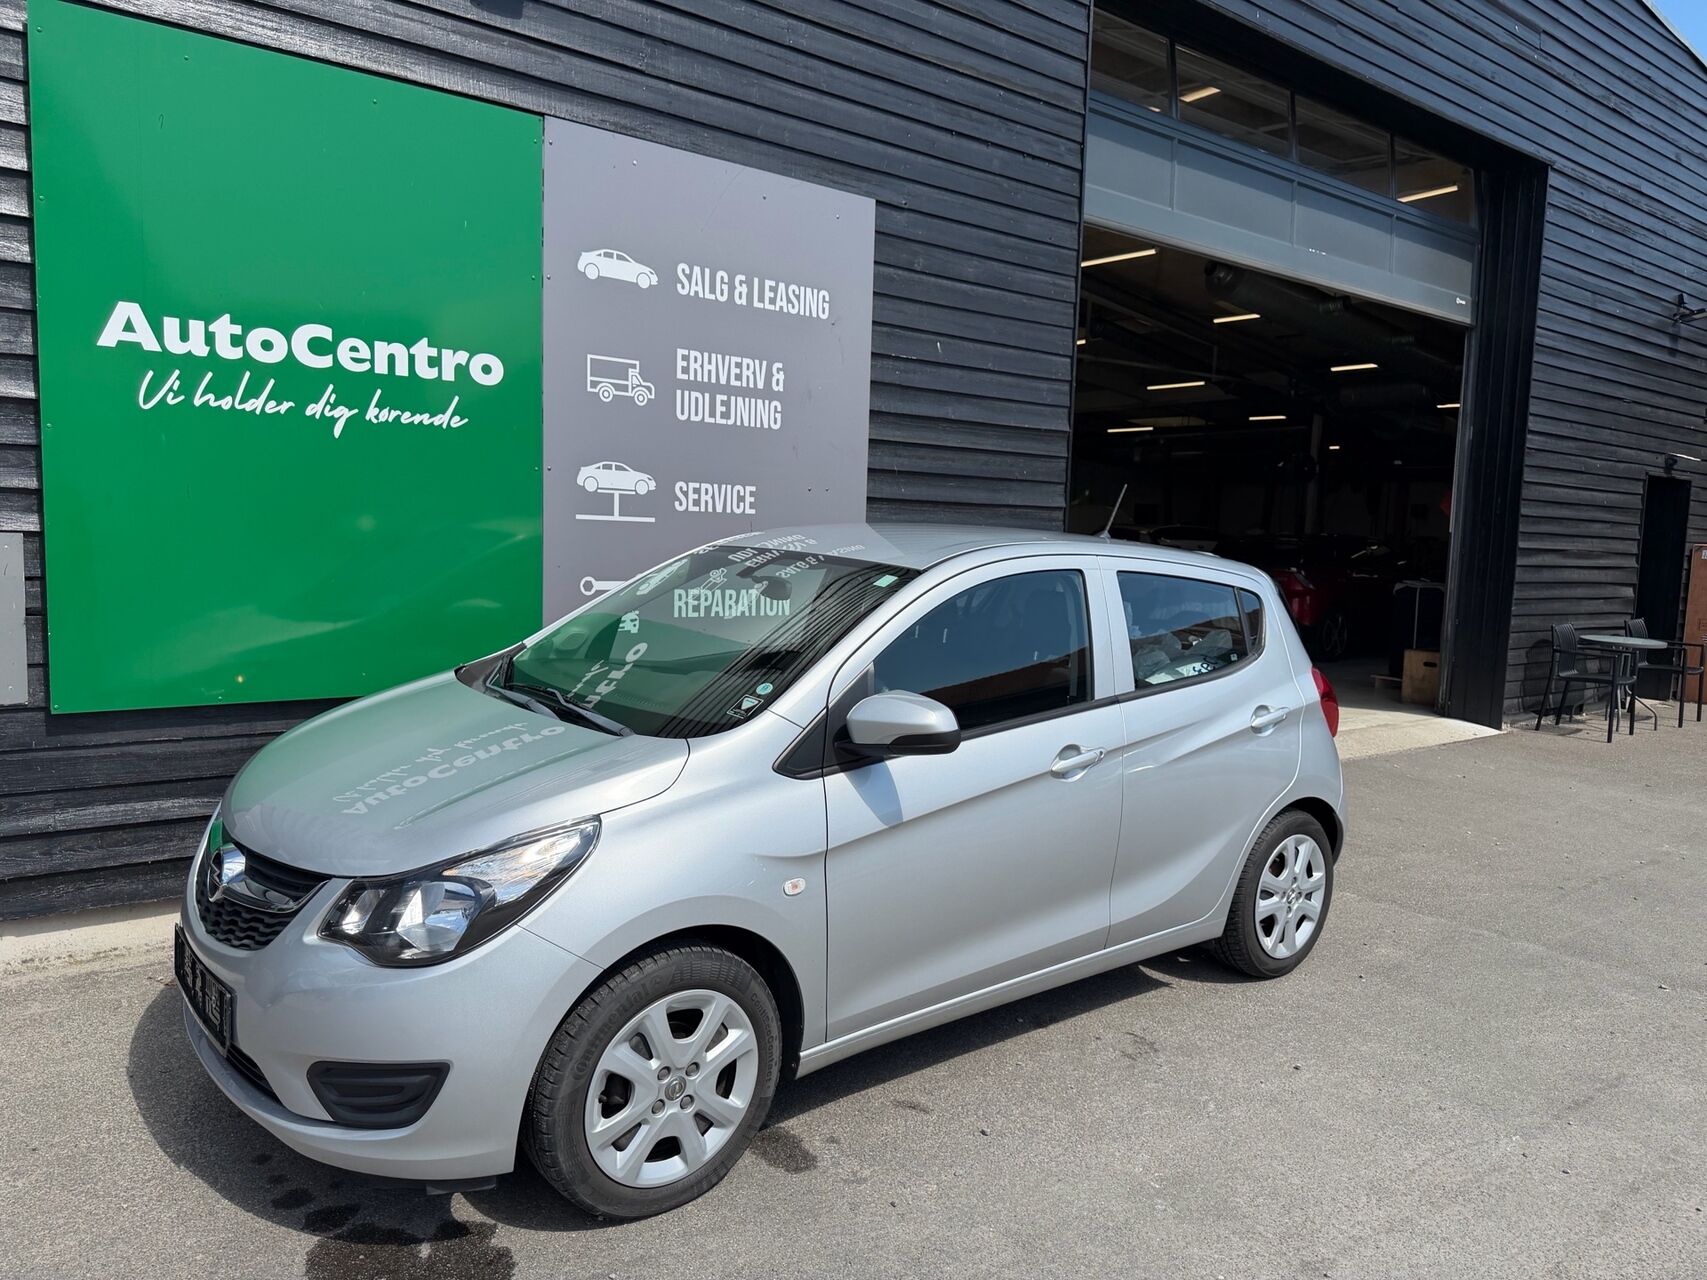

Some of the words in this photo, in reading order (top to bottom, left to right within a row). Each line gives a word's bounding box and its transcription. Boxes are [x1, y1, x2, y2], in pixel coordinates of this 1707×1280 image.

[676, 263, 728, 301] SALG
[734, 274, 748, 305] &
[753, 278, 830, 320] LEASING
[96, 300, 504, 386] AutoCentro
[676, 348, 767, 390] ERHVERV
[771, 361, 785, 392] &
[138, 369, 187, 410] Vi
[193, 371, 295, 415] holder
[304, 384, 359, 439] dig
[365, 389, 469, 429] kørende
[675, 390, 782, 430] UDLEJNING
[674, 481, 757, 515] SERVICE
[673, 589, 791, 618] REPARATION
